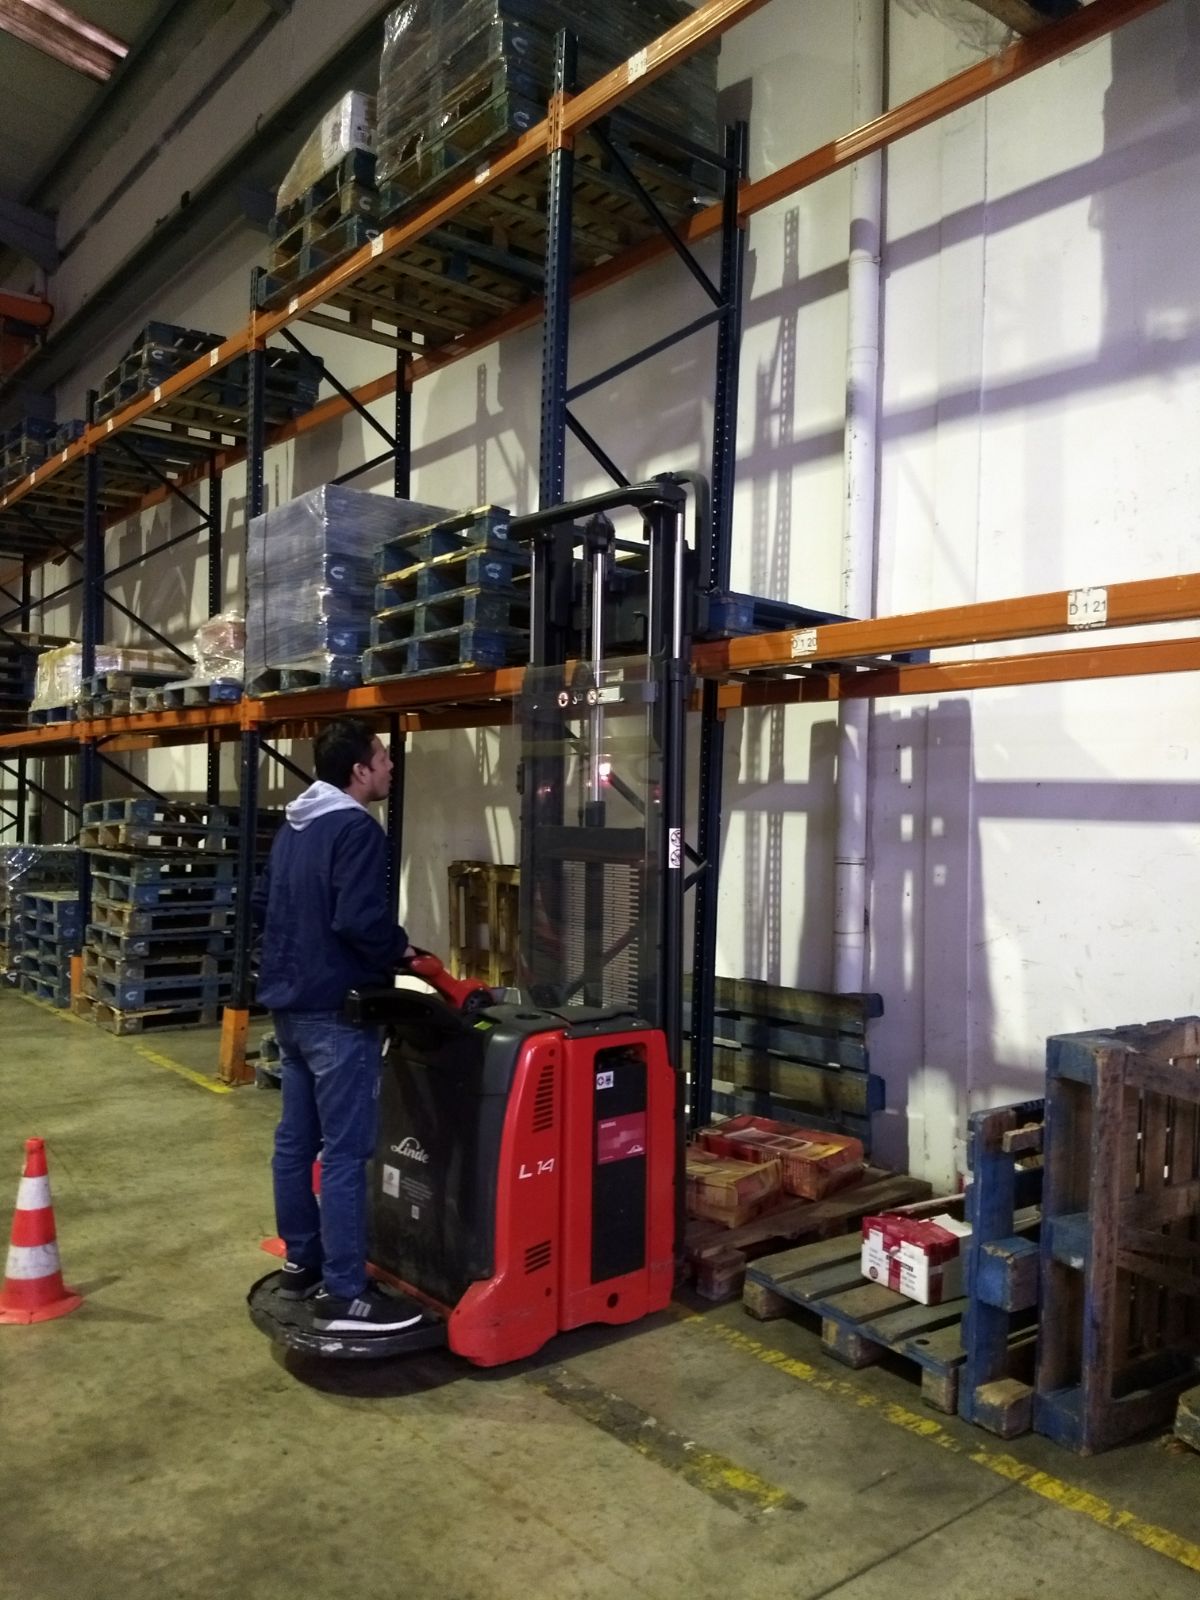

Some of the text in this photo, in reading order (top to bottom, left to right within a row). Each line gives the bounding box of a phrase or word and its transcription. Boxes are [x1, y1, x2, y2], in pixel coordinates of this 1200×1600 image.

[1069, 600, 1106, 616] D 1 21
[390, 1136, 430, 1164] Linde
[518, 1158, 555, 1180] L 14
